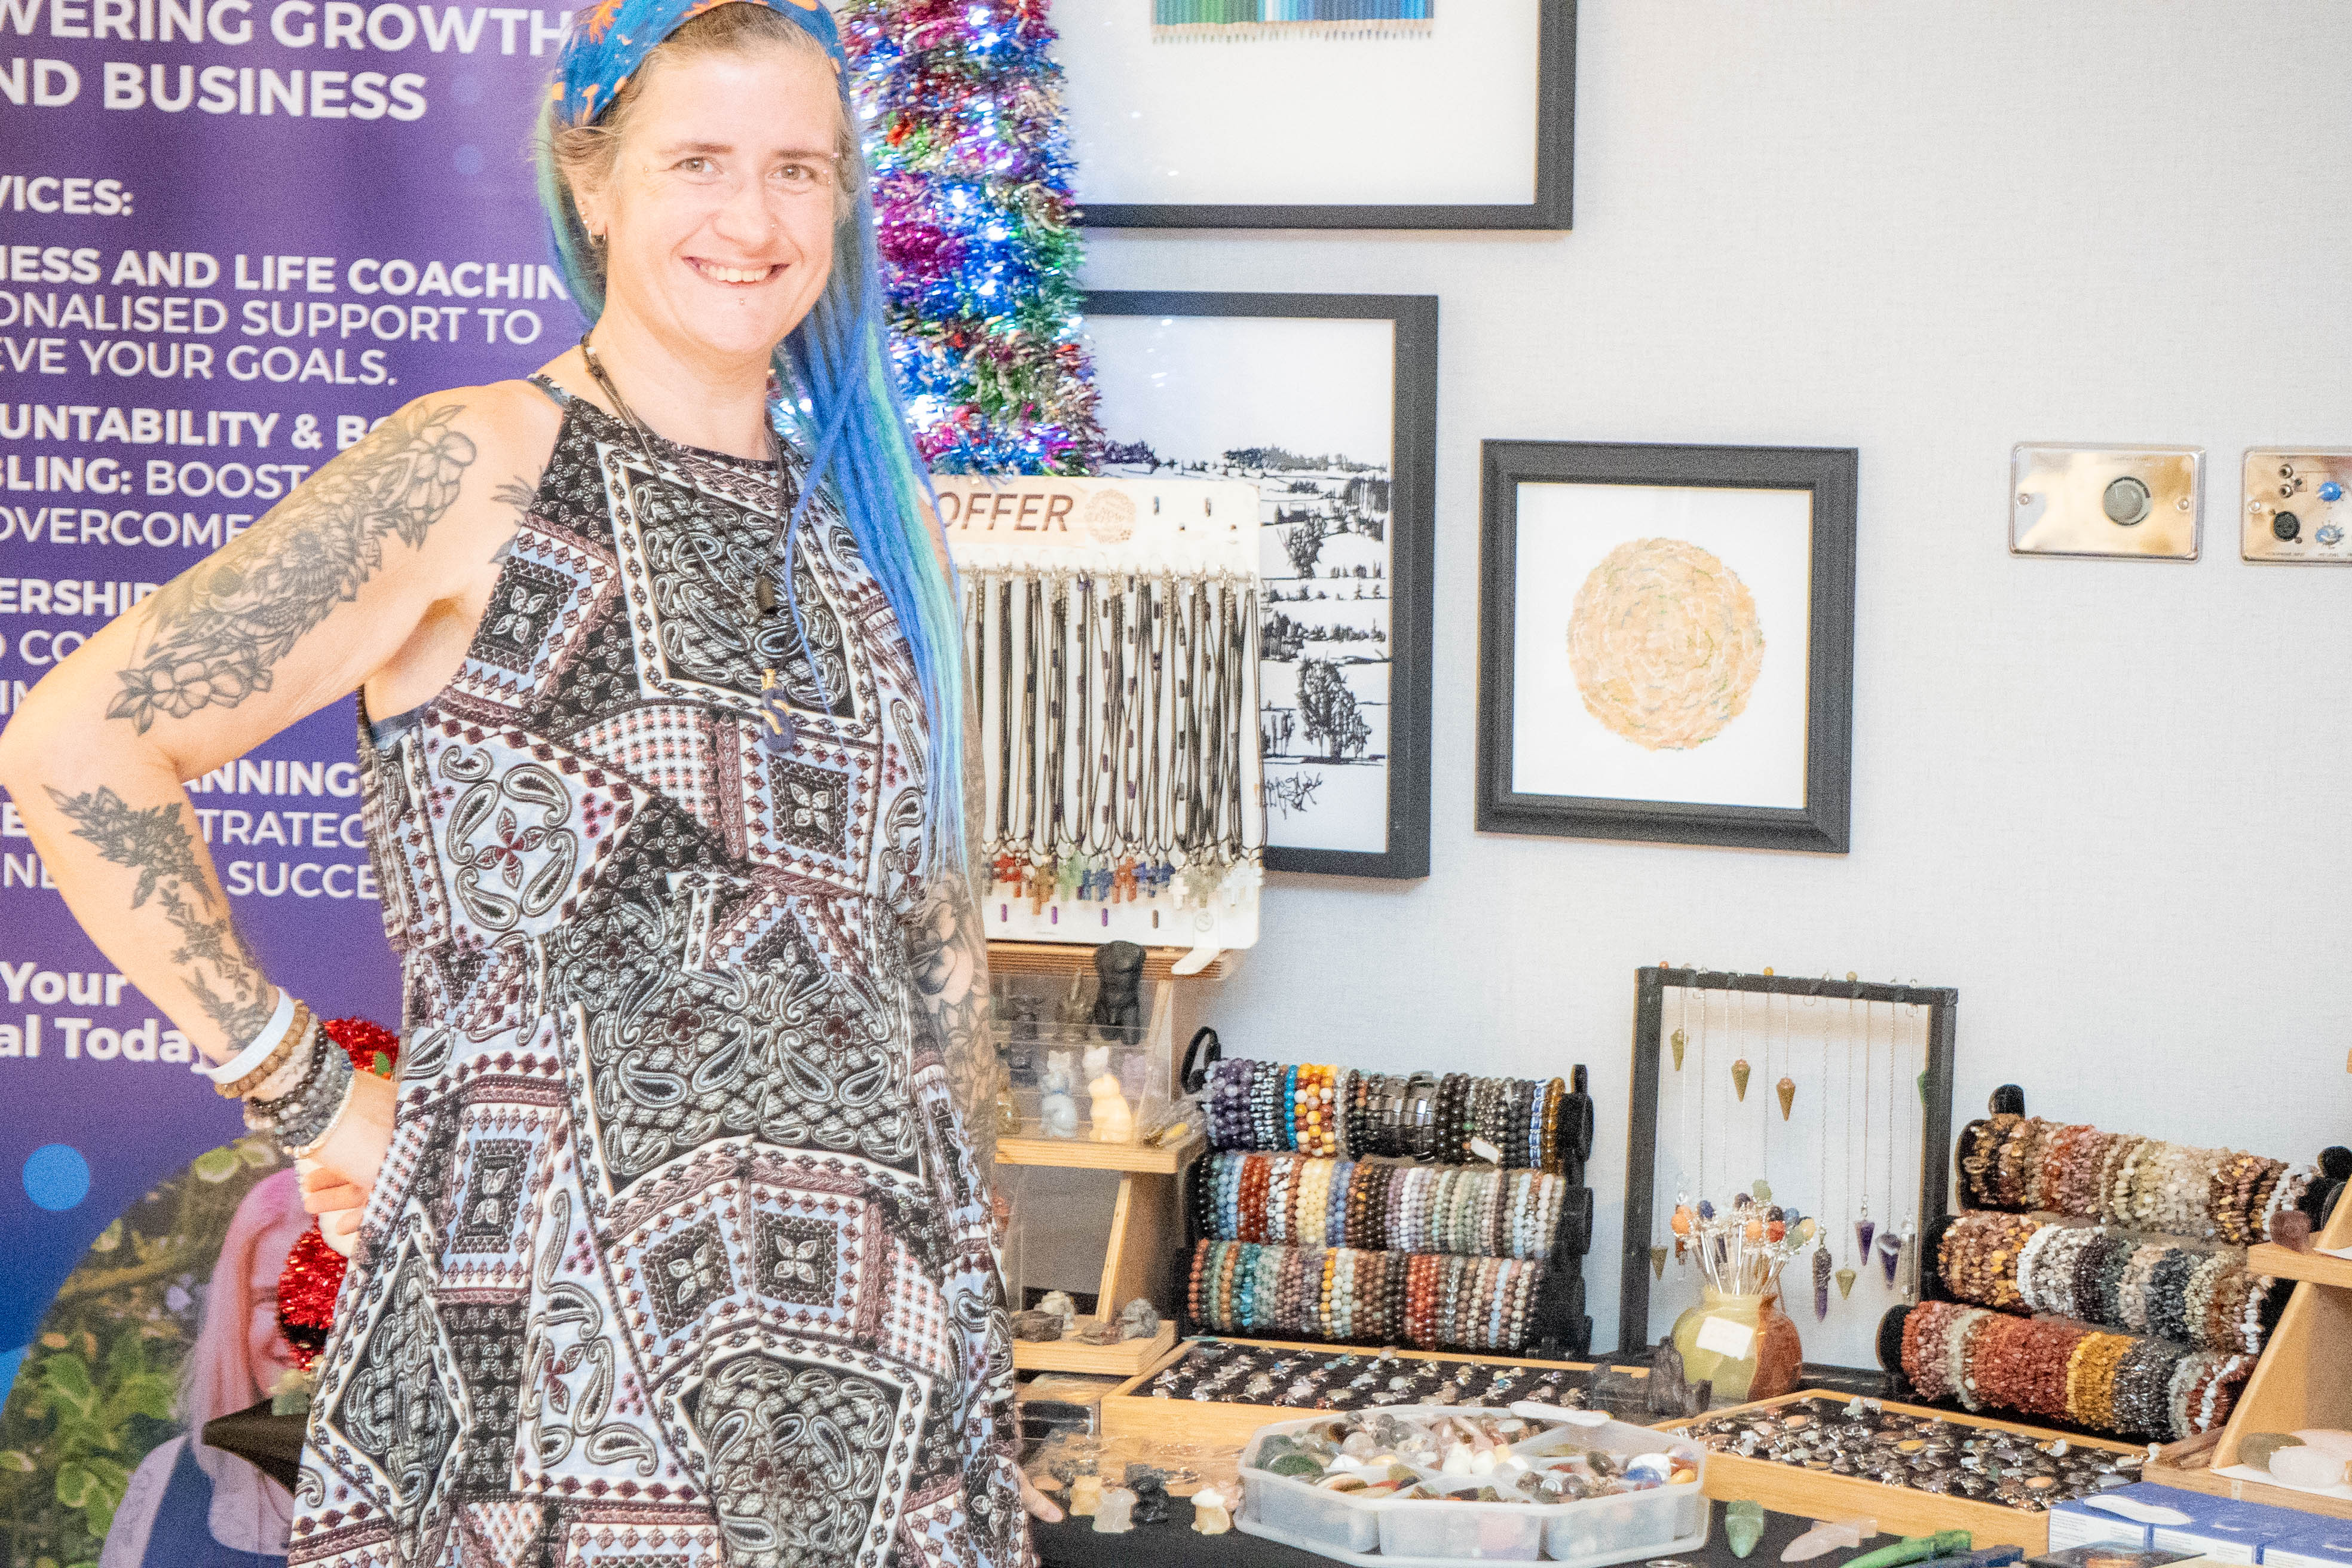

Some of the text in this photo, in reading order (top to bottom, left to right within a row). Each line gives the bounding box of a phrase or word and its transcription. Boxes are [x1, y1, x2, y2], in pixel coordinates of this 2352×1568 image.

[271, 1, 574, 57] GROWTH
[104, 62, 427, 121] BUSINESS
[0, 246, 98, 283] ESS
[112, 251, 217, 287] AND
[235, 255, 335, 292] LIFE
[242, 301, 467, 341] SUPPORT
[478, 308, 541, 344] TO
[0, 337, 397, 385] VE YOUR GOALS.
[0, 404, 278, 447] UNTABILITY
[292, 414, 321, 449] &
[0, 455, 310, 500] LING: BOOST
[938, 492, 1074, 531] OFFER
[181, 760, 360, 797] NNING
[0, 962, 127, 1006] Your
